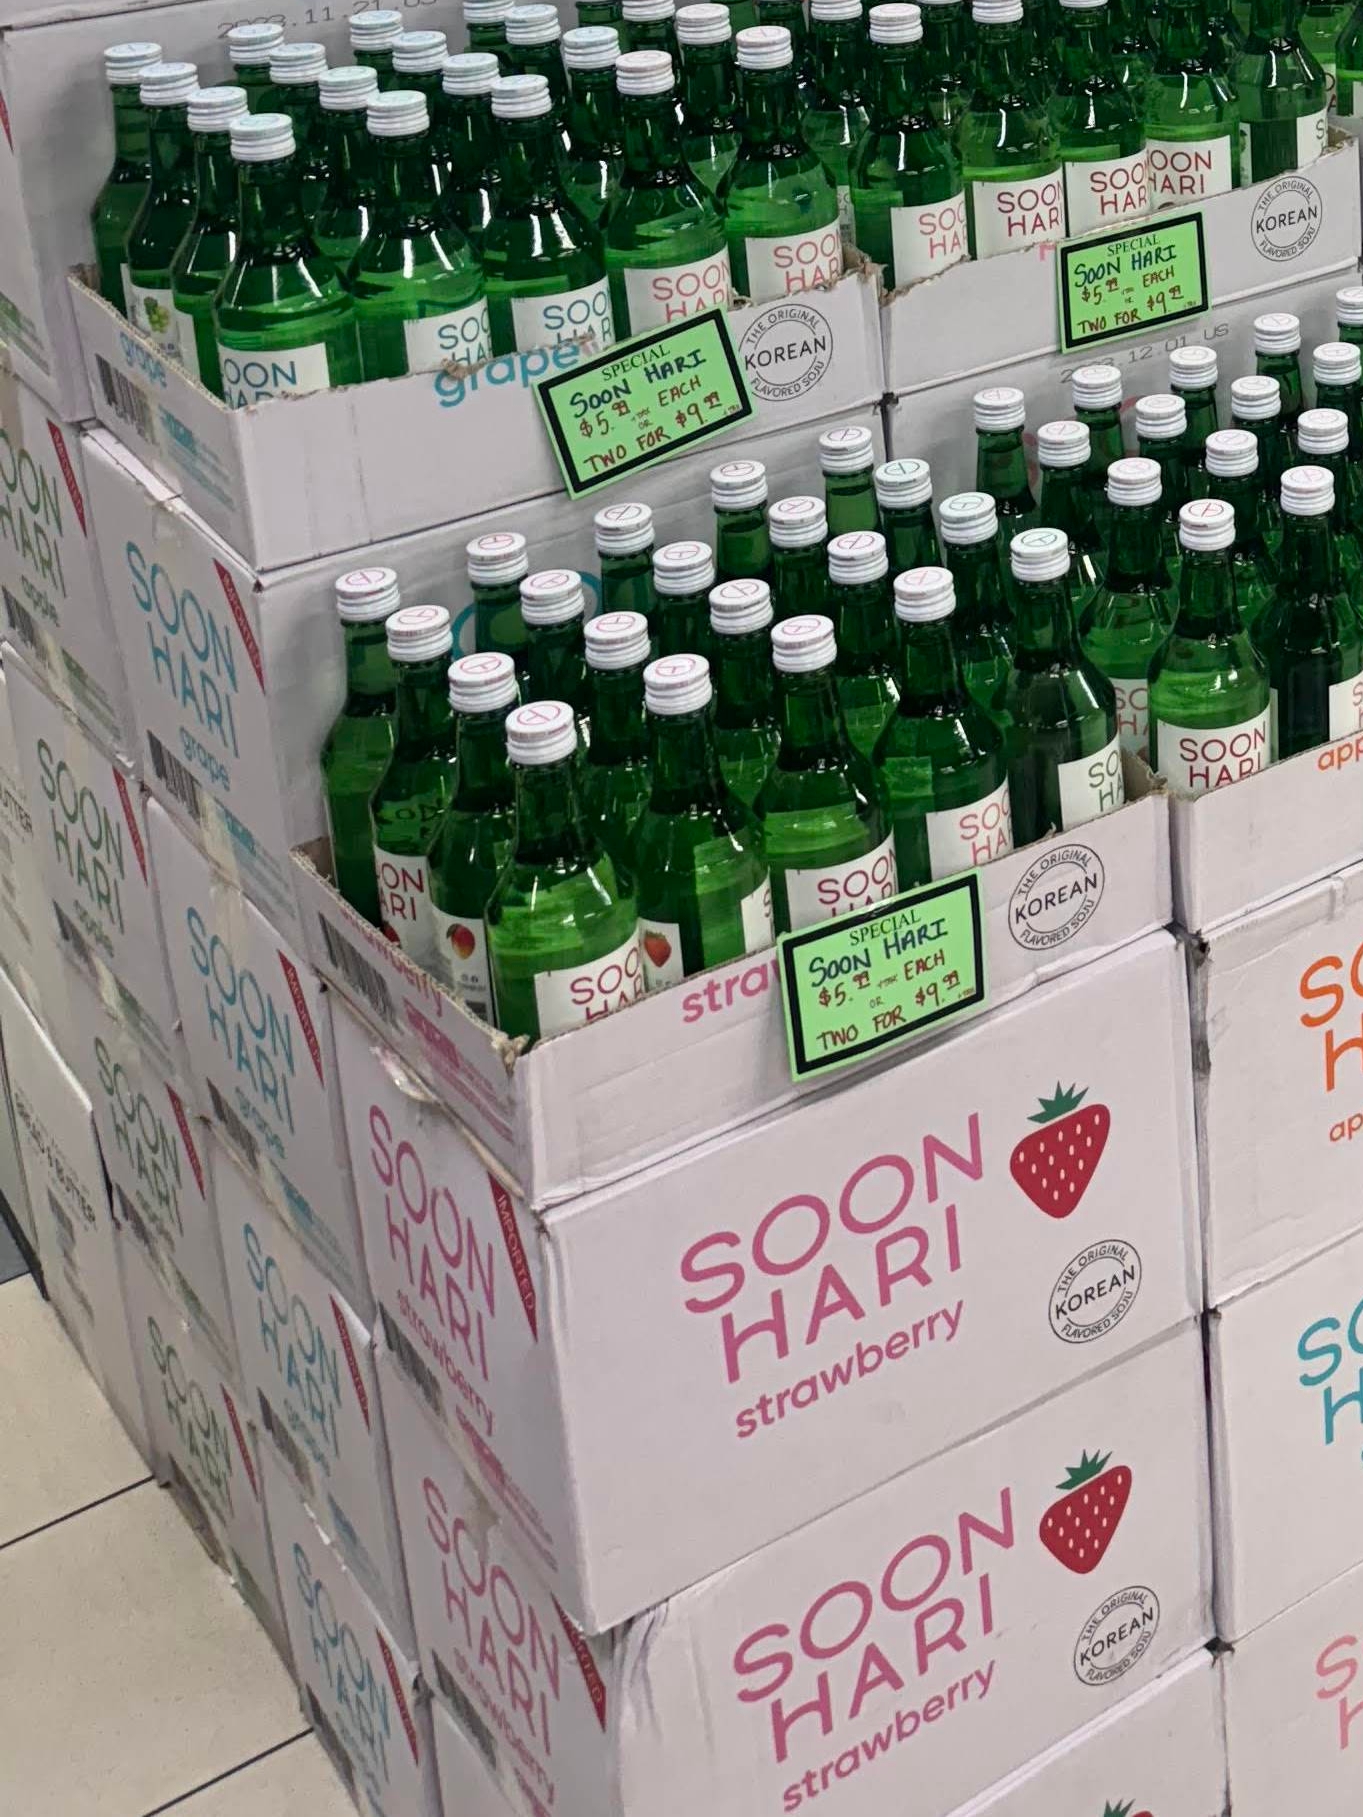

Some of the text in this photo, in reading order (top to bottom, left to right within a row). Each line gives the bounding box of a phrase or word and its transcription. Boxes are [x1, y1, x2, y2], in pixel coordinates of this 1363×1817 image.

[1275, 180, 1314, 202] ORIGINAL
[1256, 204, 1318, 233] KOREAN
[1107, 234, 1160, 257] SPECIAL
[1131, 245, 1176, 271] HARI
[1143, 266, 1174, 288] EACH
[1077, 317, 1107, 334] TWO
[1114, 309, 1141, 326] FOR
[602, 344, 670, 381] SPECIAL
[644, 349, 706, 383] HARI
[745, 336, 826, 370] KOREAN
[657, 375, 701, 406] EACH
[584, 444, 627, 472] TWO
[637, 426, 671, 451] FOR
[1180, 723, 1265, 762] SOON
[1015, 873, 1098, 924] KOREAN
[850, 910, 922, 946] SPECIAL
[884, 918, 948, 959] HARI
[905, 950, 945, 981] EACH
[816, 1006, 906, 1050] TWO FOR
[680, 1113, 983, 1313] SOON
[498, 1194, 535, 1309] IMPORTED
[722, 1204, 961, 1382] HARI
[1055, 1265, 1135, 1319] KOREAN
[736, 1300, 964, 1438] strawberry
[734, 1487, 1014, 1703] SOON
[1080, 1605, 1154, 1665] KOREAN
[771, 1573, 994, 1764] HARI
[782, 1660, 995, 1813] strawberry
